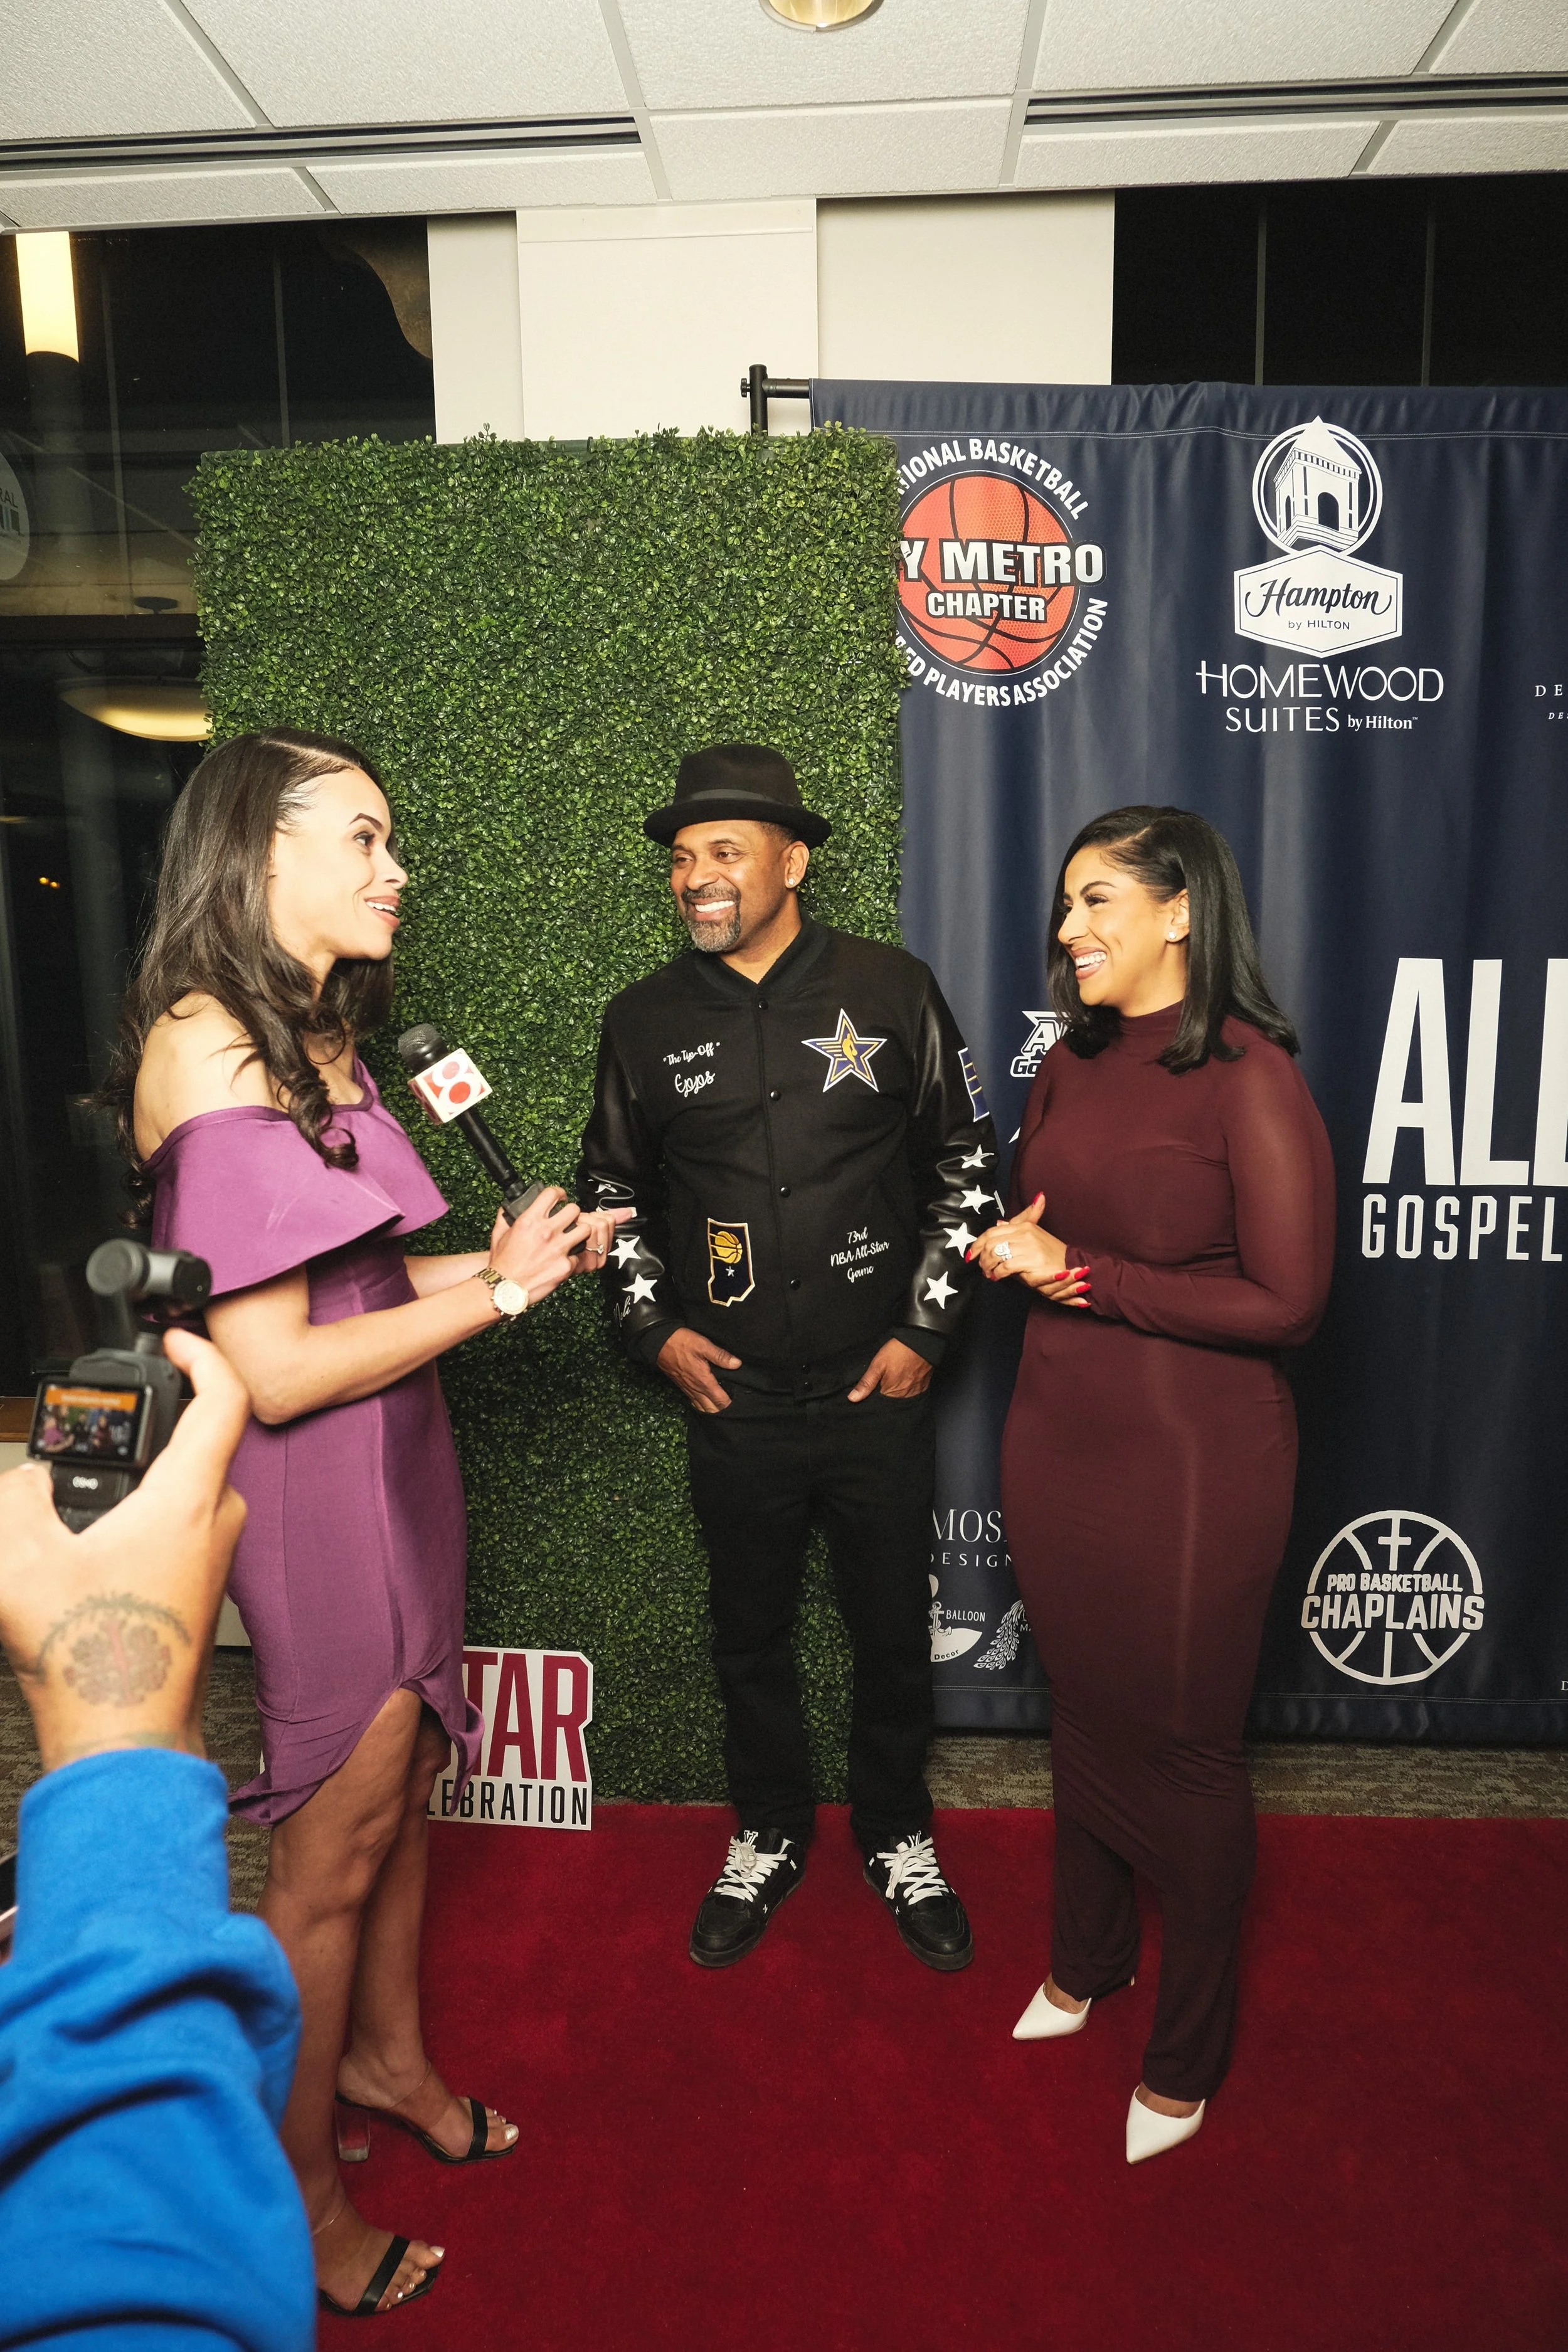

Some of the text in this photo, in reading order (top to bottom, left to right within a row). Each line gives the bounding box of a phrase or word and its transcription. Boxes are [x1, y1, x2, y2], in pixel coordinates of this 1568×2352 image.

[896, 438, 1089, 520] TIONAL BASKETBALL
[942, 541, 1103, 584] METRO
[928, 593, 1045, 621] CHAPTER
[1244, 577, 1392, 617] Hampton
[1288, 620, 1350, 630] by HILTON
[923, 667, 1009, 706] PLAYERS
[1014, 598, 1108, 706] ASSOCIATION
[1195, 660, 1444, 702] HOMEWOOD
[1225, 707, 1339, 732] SUITES
[1347, 714, 1363, 731] by
[432, 1051, 481, 1115] 8
[674, 1070, 716, 1098] Epps
[1362, 957, 1568, 1186] ALL
[847, 1226, 869, 1244] 73rd
[1362, 1194, 1562, 1261] GOSPEL
[830, 1241, 889, 1266] NBA All-Star
[847, 1266, 874, 1283] Game
[932, 1508, 1007, 1543] MOS
[1327, 1573, 1463, 1592] PRO BASKETBALL
[946, 1609, 986, 1622] BALLOON
[1301, 1594, 1485, 1631] CHAPLAINS
[934, 1650, 959, 1660] Decor
[438, 1650, 588, 1783] TAR
